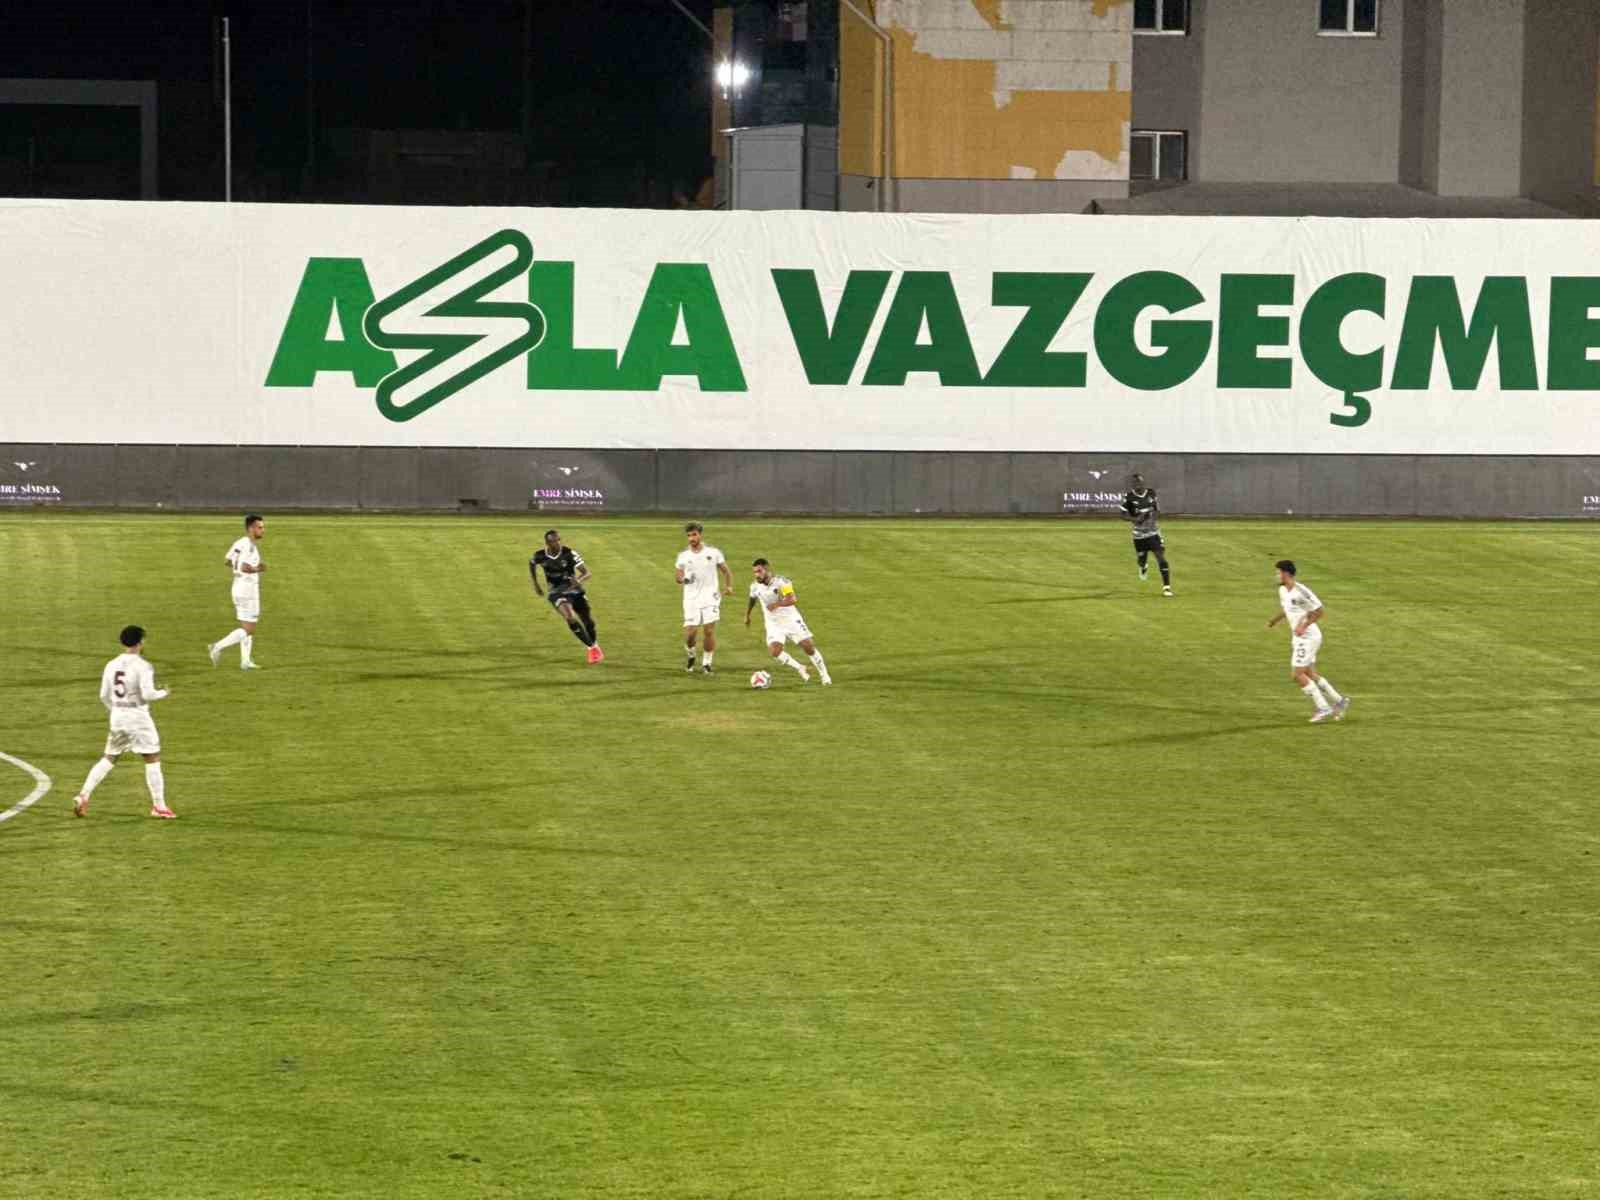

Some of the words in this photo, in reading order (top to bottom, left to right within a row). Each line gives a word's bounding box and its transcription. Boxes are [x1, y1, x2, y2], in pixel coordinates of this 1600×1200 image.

[265, 230, 747, 422] ASLA
[772, 269, 1600, 427] VAZGEÇME
[113, 671, 126, 699] 5
